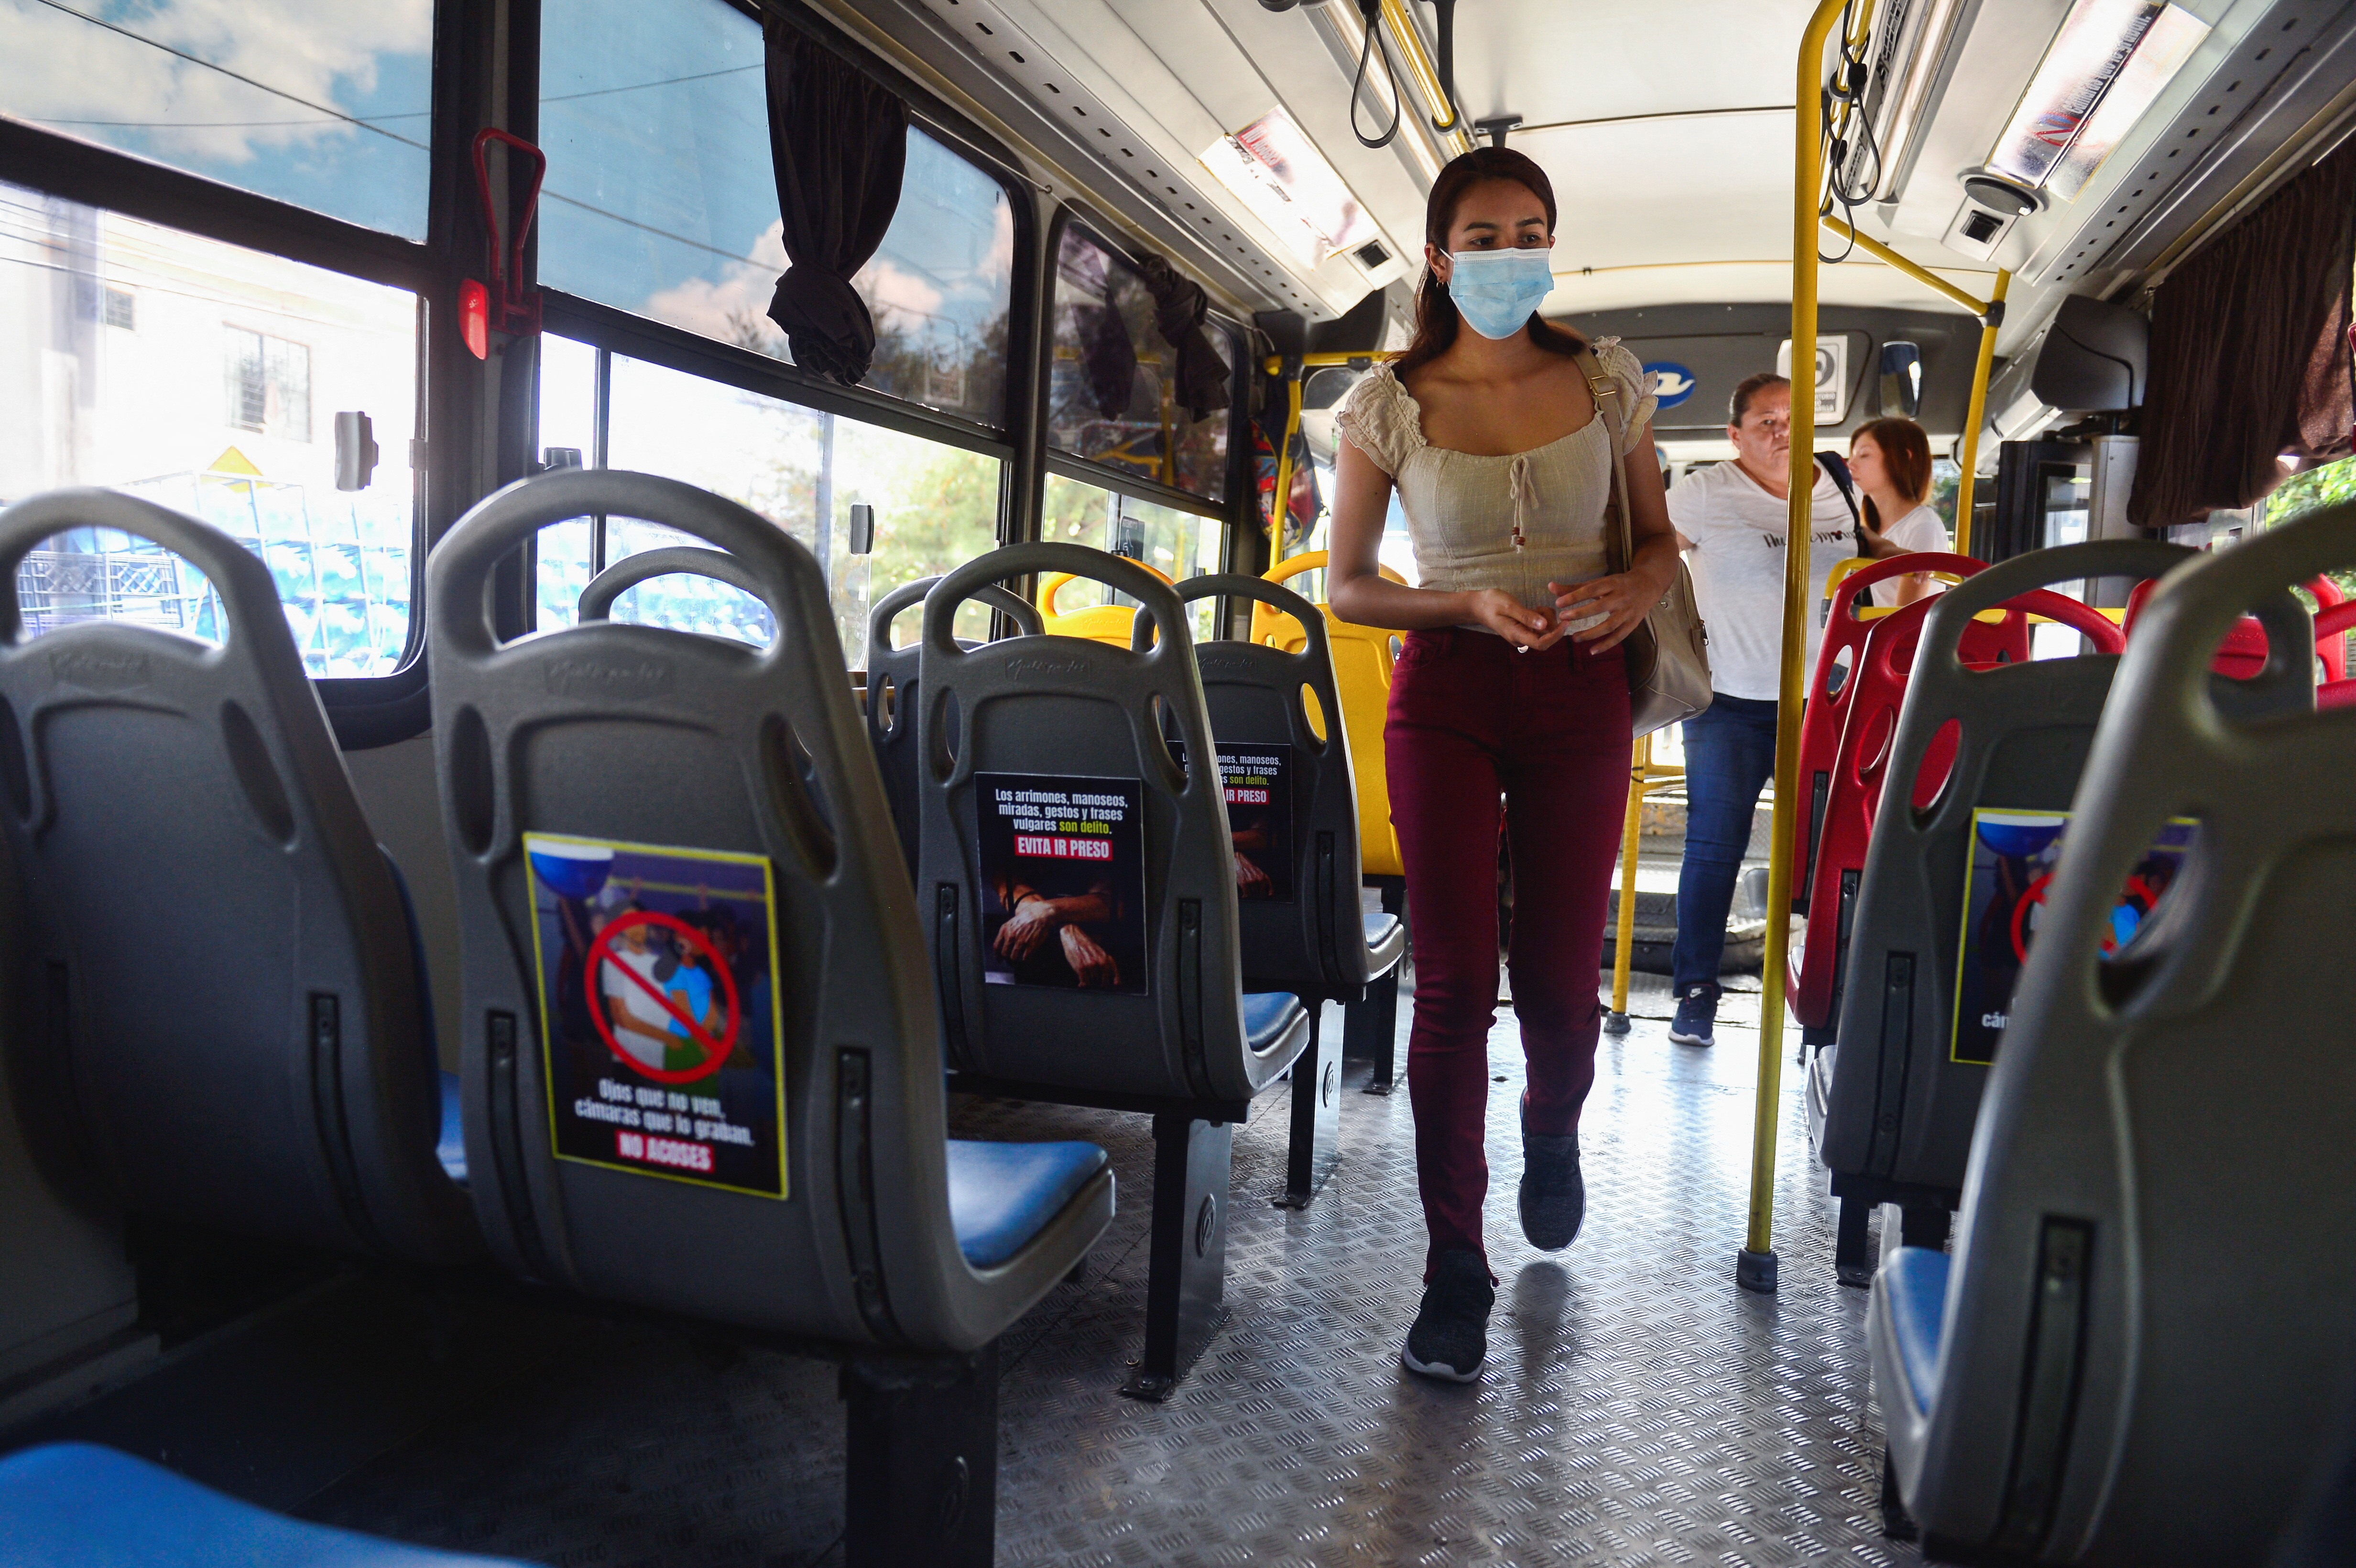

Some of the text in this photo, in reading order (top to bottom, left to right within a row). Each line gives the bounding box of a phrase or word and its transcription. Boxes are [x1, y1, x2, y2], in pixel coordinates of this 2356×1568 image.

[1220, 765, 1277, 775] gestos y frases
[1240, 756, 1281, 766] manoseos,
[1245, 775, 1269, 785] delito.
[995, 789, 1128, 808] Los arrimones, manoseos,
[1226, 789, 1266, 803] IR PRESO
[999, 803, 1123, 821] miradas, gestos y frases
[1013, 817, 1112, 834] vulgares son delito.
[1018, 837, 1109, 858] EVITA IR PRESO
[599, 1078, 633, 1102] Ojos
[635, 1086, 665, 1108] que
[667, 1091, 689, 1112] no
[643, 1111, 673, 1132] que
[675, 1113, 692, 1135] lo
[620, 1132, 644, 1158] NO
